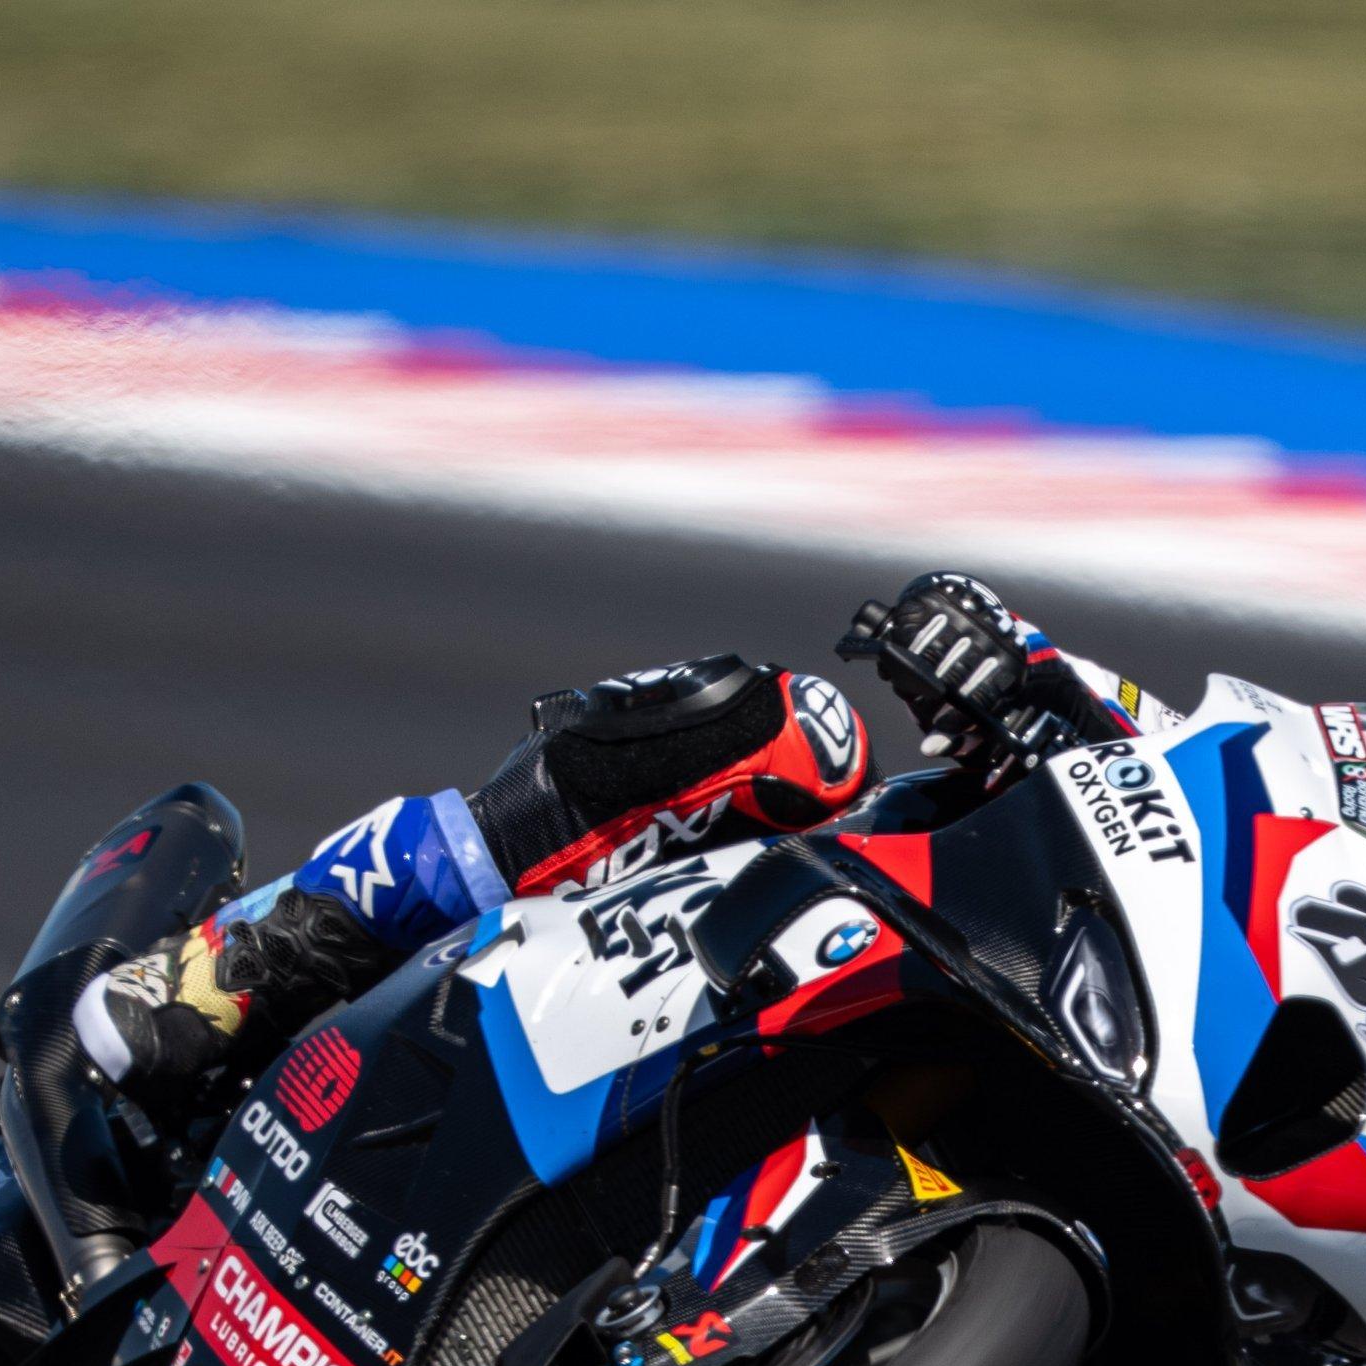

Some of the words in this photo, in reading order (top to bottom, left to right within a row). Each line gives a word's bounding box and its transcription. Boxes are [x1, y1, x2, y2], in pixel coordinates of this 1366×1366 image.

[1319, 705, 1366, 760] WRS
[1069, 761, 1137, 857] OXYGEN
[241, 1100, 311, 1181] OUTDO
[394, 1232, 440, 1279] ebc
[375, 1270, 411, 1302] group
